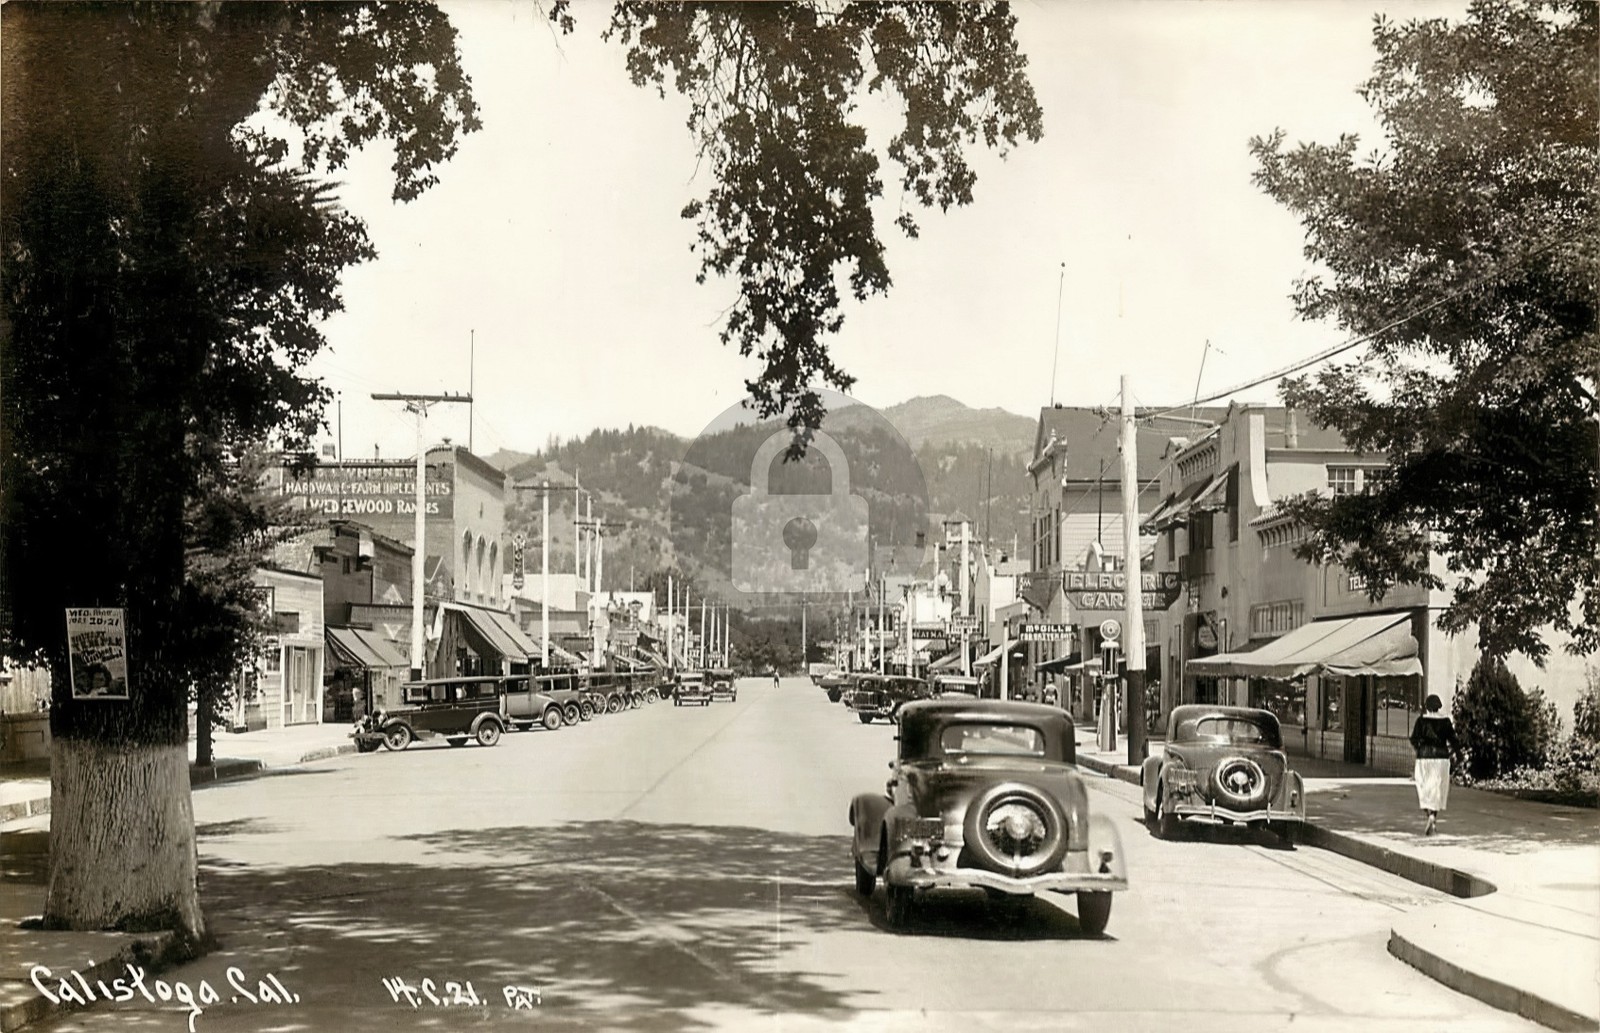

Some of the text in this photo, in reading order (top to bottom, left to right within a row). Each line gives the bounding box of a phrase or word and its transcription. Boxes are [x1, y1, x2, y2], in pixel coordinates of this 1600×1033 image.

[397, 499, 439, 514] RANES
[1070, 573, 1177, 590] ELECRIC
[1081, 592, 1166, 608] GARGE
